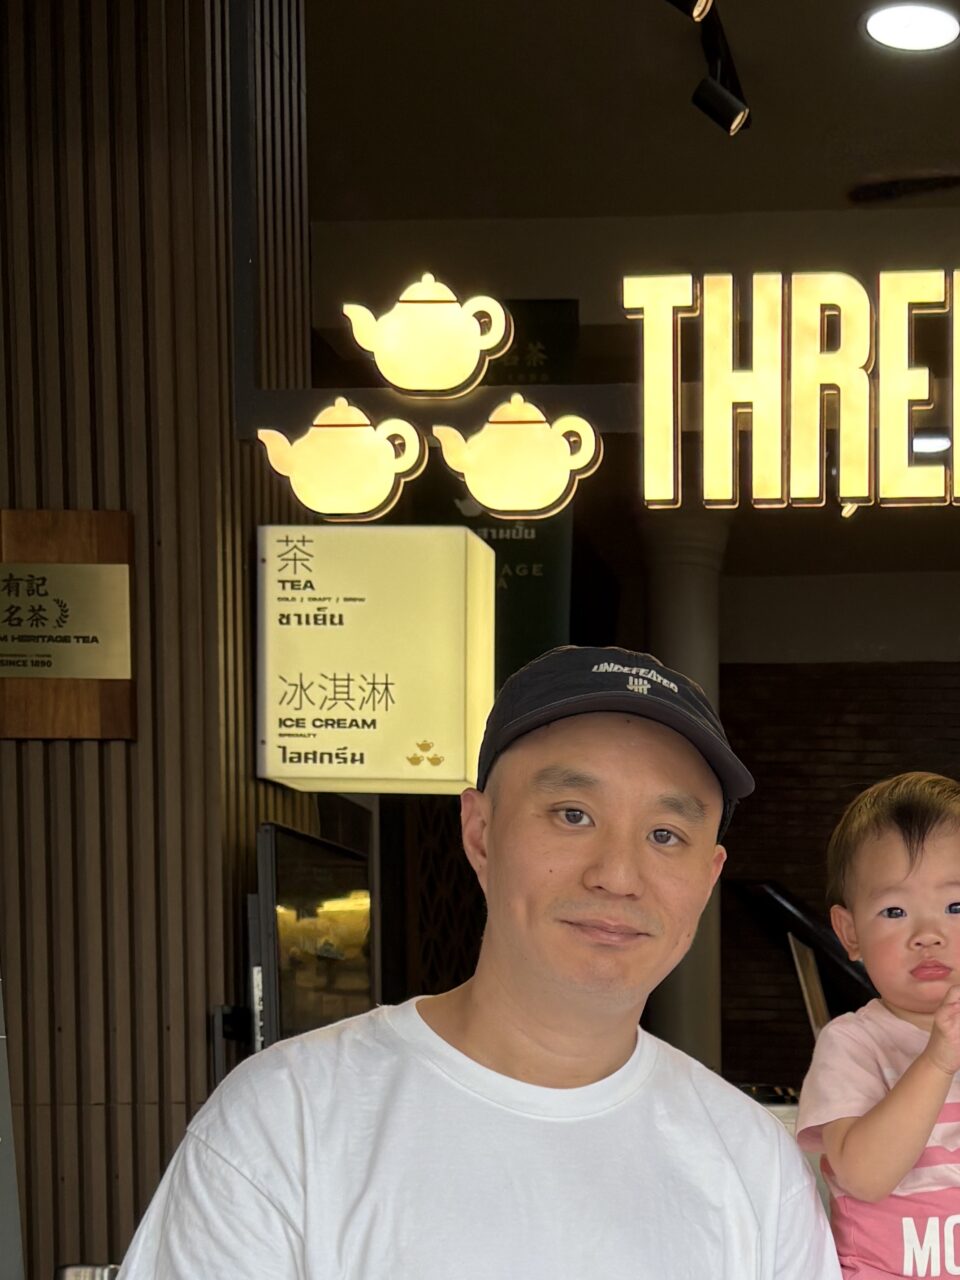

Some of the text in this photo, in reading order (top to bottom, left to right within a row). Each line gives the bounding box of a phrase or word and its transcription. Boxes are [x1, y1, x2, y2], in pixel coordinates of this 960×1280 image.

[276, 535, 314, 575] 茶
[1, 572, 49, 597] 有記
[277, 580, 315, 591] TEA
[2, 604, 49, 628] 名茶
[11, 634, 72, 644] HERITAGE
[73, 635, 100, 644] TEA
[0, 659, 28, 668] SINCE
[591, 662, 679, 693] UNDEFEATED
[278, 672, 396, 712] 冰淇淋
[278, 718, 377, 730] ICE CREAM
